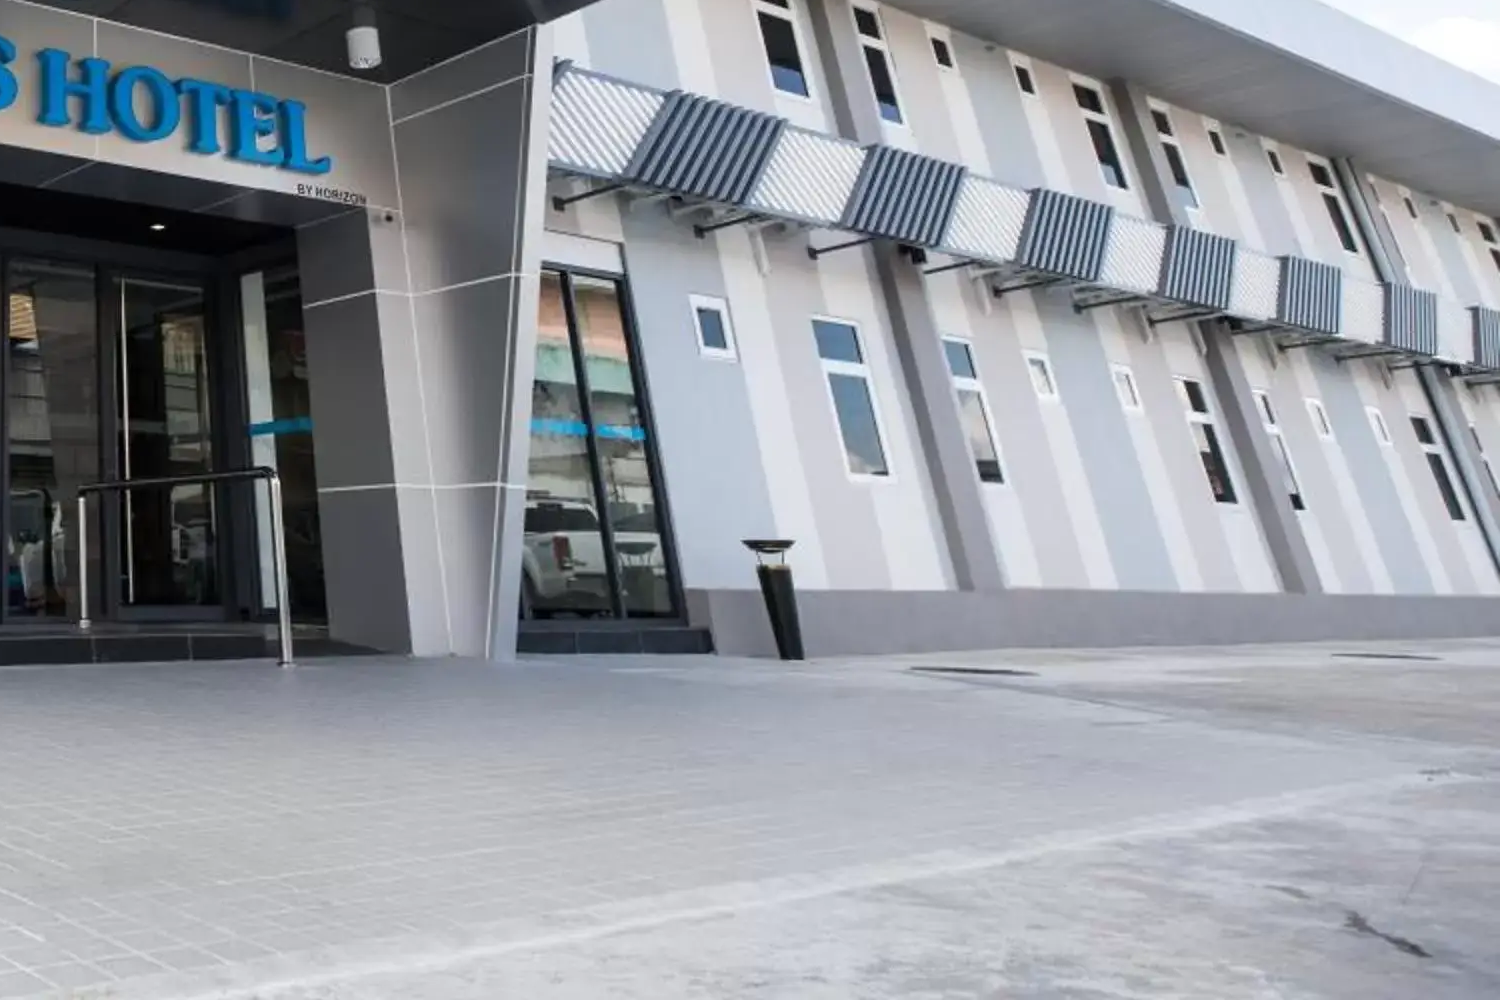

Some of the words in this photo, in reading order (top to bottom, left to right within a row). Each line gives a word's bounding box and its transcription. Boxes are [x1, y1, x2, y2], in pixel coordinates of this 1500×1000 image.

[35, 47, 332, 175] HOTEL
[297, 183, 313, 196] BY
[315, 186, 367, 205] HORIZON
